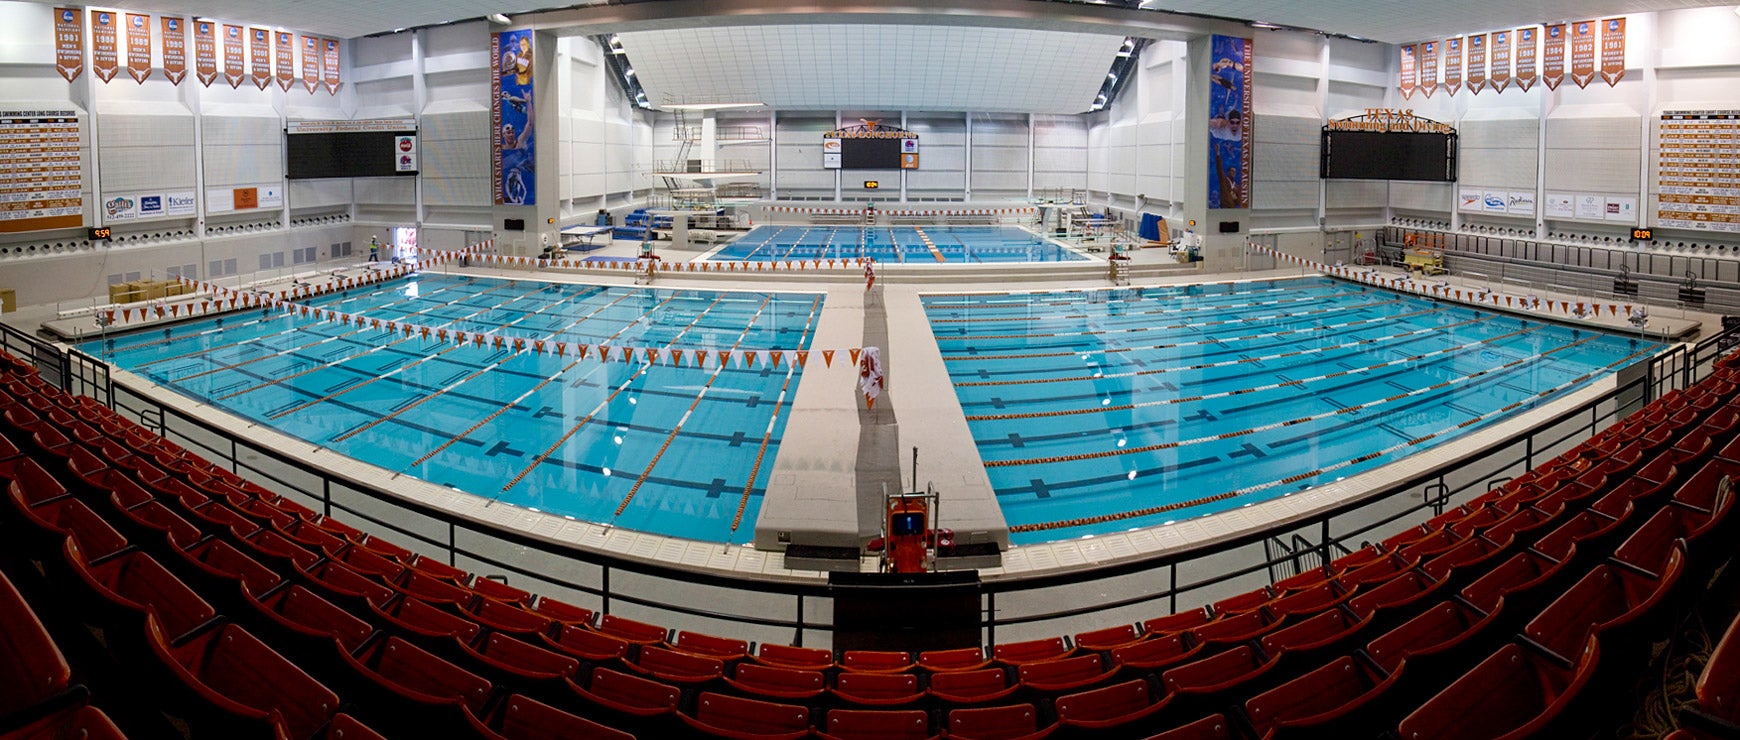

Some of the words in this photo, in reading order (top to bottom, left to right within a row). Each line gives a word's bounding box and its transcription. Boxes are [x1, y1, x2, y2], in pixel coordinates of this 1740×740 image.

[1365, 108, 1414, 120] TEXAS
[1243, 117, 1249, 128] OF
[1328, 119, 1386, 132] Swimming
[1389, 120, 1410, 131] and
[1413, 120, 1451, 133] Diving
[1242, 160, 1248, 170] AT
[173, 197, 194, 206] Kiefer
[95, 229, 110, 238] 9:59
[1633, 231, 1651, 239] 10:09
